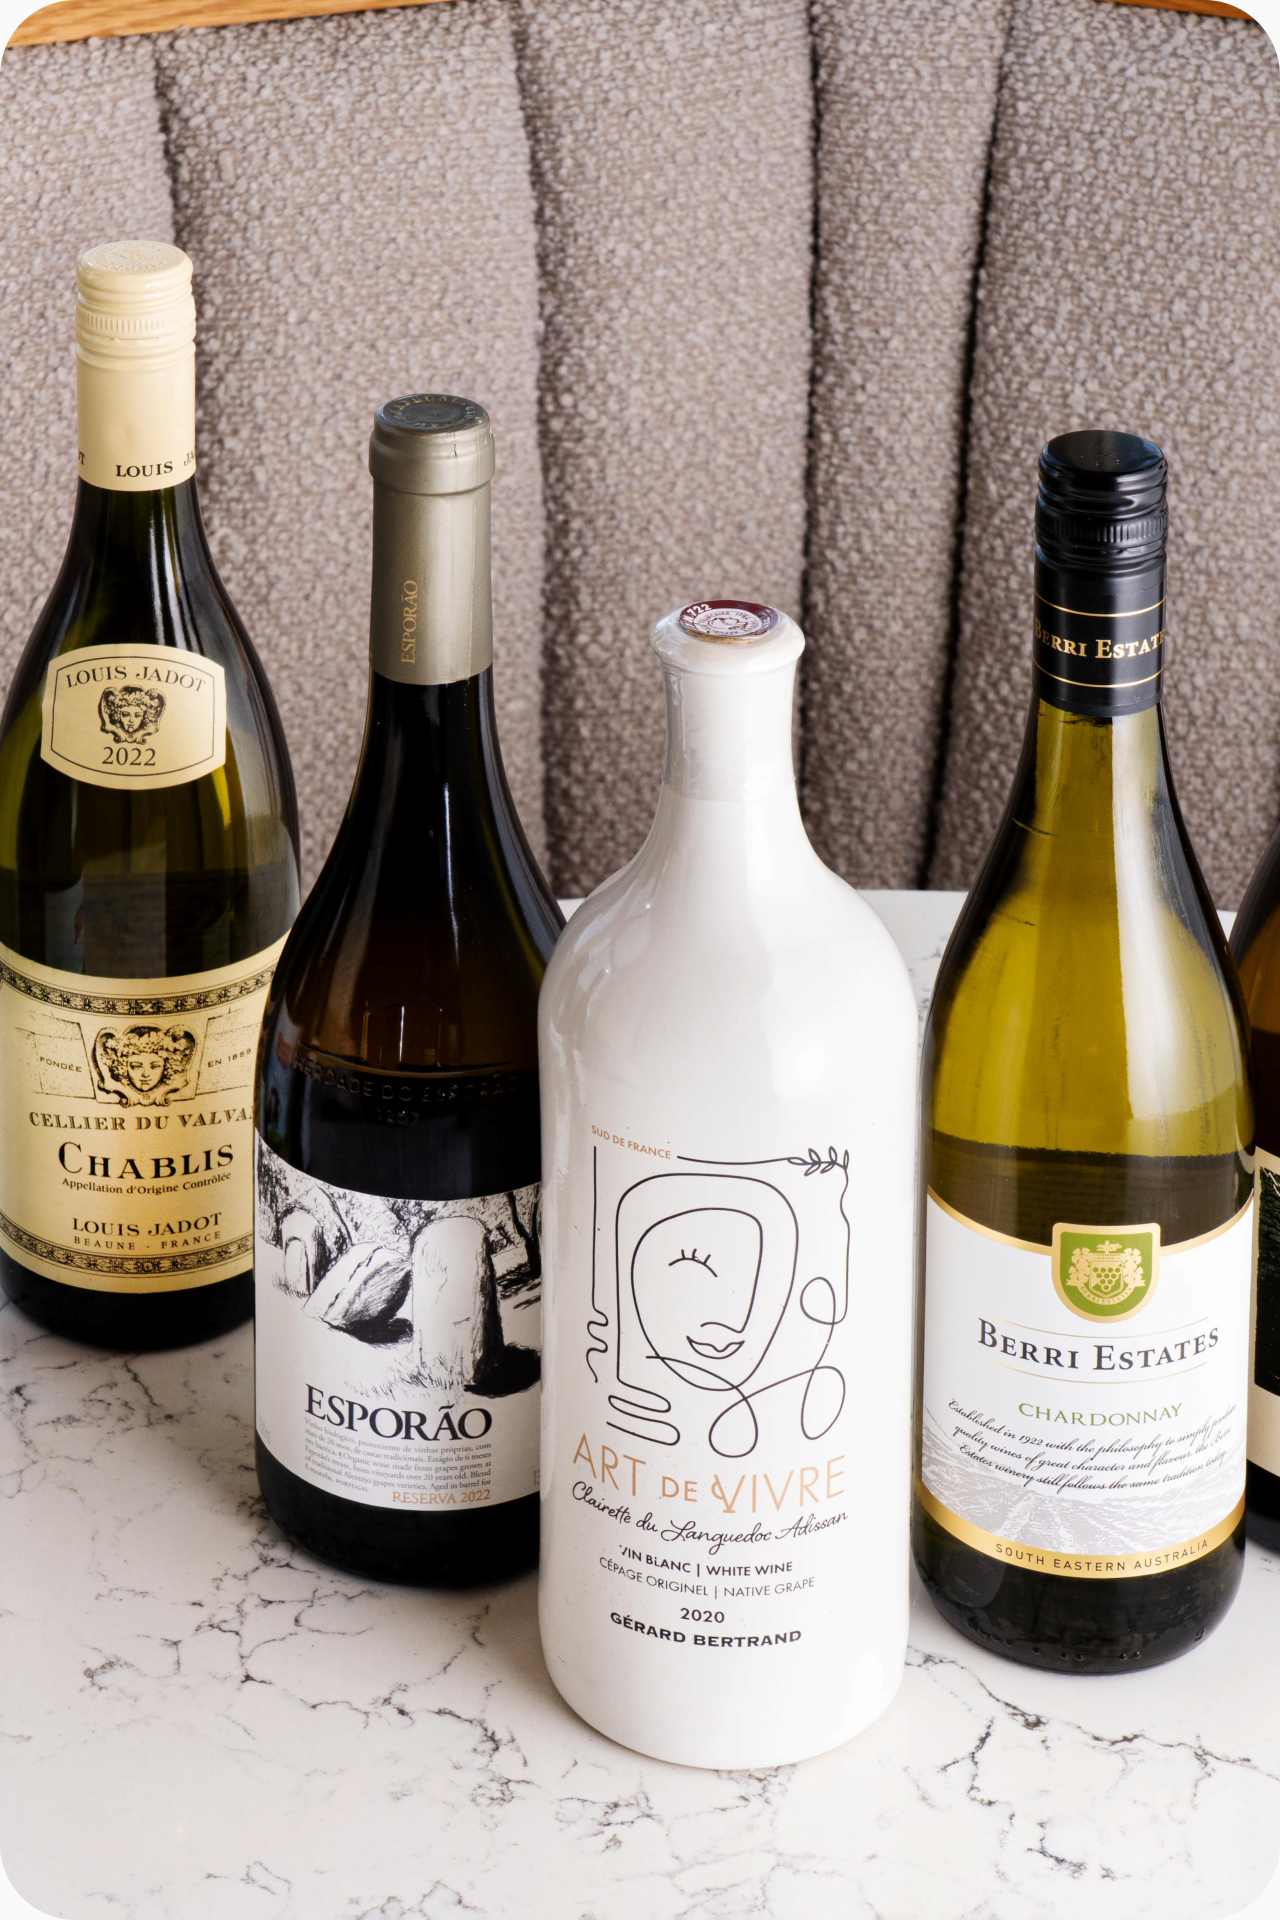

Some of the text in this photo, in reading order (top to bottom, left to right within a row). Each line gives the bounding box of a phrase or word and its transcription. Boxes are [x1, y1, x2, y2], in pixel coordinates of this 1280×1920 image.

[115, 461, 173, 477] LOUIS
[400, 580, 418, 664] ESPORÃO
[66, 665, 207, 693] LOUIS JADOT
[102, 746, 156, 766] 2022
[207, 1058, 222, 1069] EN
[30, 1106, 253, 1130] CELLIER DU VALVA
[591, 1124, 673, 1159] SUD DE FRANCE
[62, 1172, 232, 1195] Appellation d'Origine Contrôlée
[73, 1211, 222, 1237] LOUIS JADOT
[74, 1235, 135, 1250] BEAUNE
[161, 1231, 221, 1249] FRANCE
[305, 1383, 492, 1441] ESPORÃO
[1018, 1402, 1183, 1427] CHARDONNAY
[953, 1425, 988, 1452] quality
[990, 1444, 1022, 1460] wines
[1031, 1457, 1072, 1474] great
[1071, 1457, 1125, 1471] character
[1003, 1429, 1016, 1440] in
[1018, 1435, 1044, 1445] 1922
[1045, 1438, 1079, 1450] with
[572, 1432, 846, 1514] ART DE VIVRE
[960, 1444, 993, 1467] Estates
[995, 1464, 1036, 1487] winery
[392, 1488, 491, 1505] RESERVA 2022
[572, 1480, 849, 1555] Clairette du Languedoc Adissan
[646, 1554, 692, 1574] BLANC
[706, 1564, 751, 1577] WHITE
[755, 1561, 793, 1576] WINE
[995, 1539, 1209, 1573] SOUTH EASTERN AUSTRALIA
[599, 1555, 643, 1583] CÉPAGE
[646, 1574, 709, 1597] ORIGINEL
[723, 1585, 771, 1598] NATIVE
[774, 1577, 815, 1595] GRAPE
[680, 1607, 725, 1624] 2020
[610, 1611, 802, 1649] GÉRARD BERTRAND
